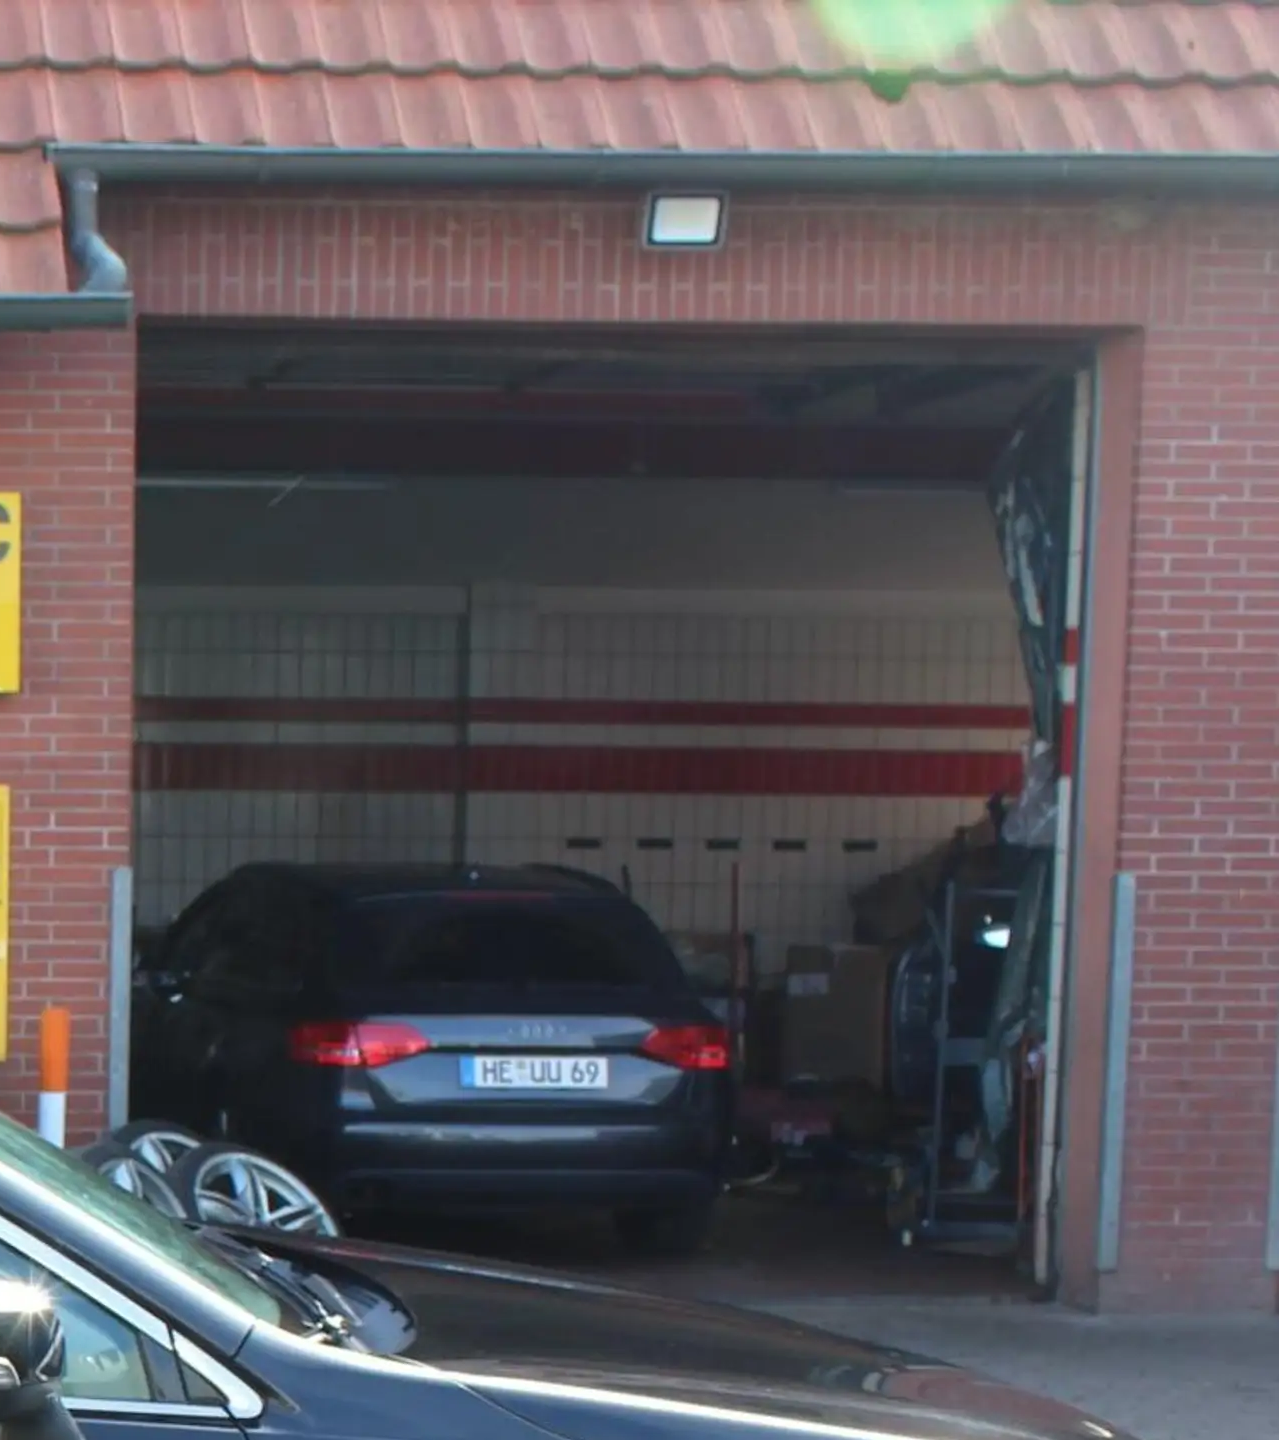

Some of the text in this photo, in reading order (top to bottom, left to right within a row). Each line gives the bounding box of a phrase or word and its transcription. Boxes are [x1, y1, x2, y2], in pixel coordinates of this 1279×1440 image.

[482, 1060, 599, 1083] HE UU 69
